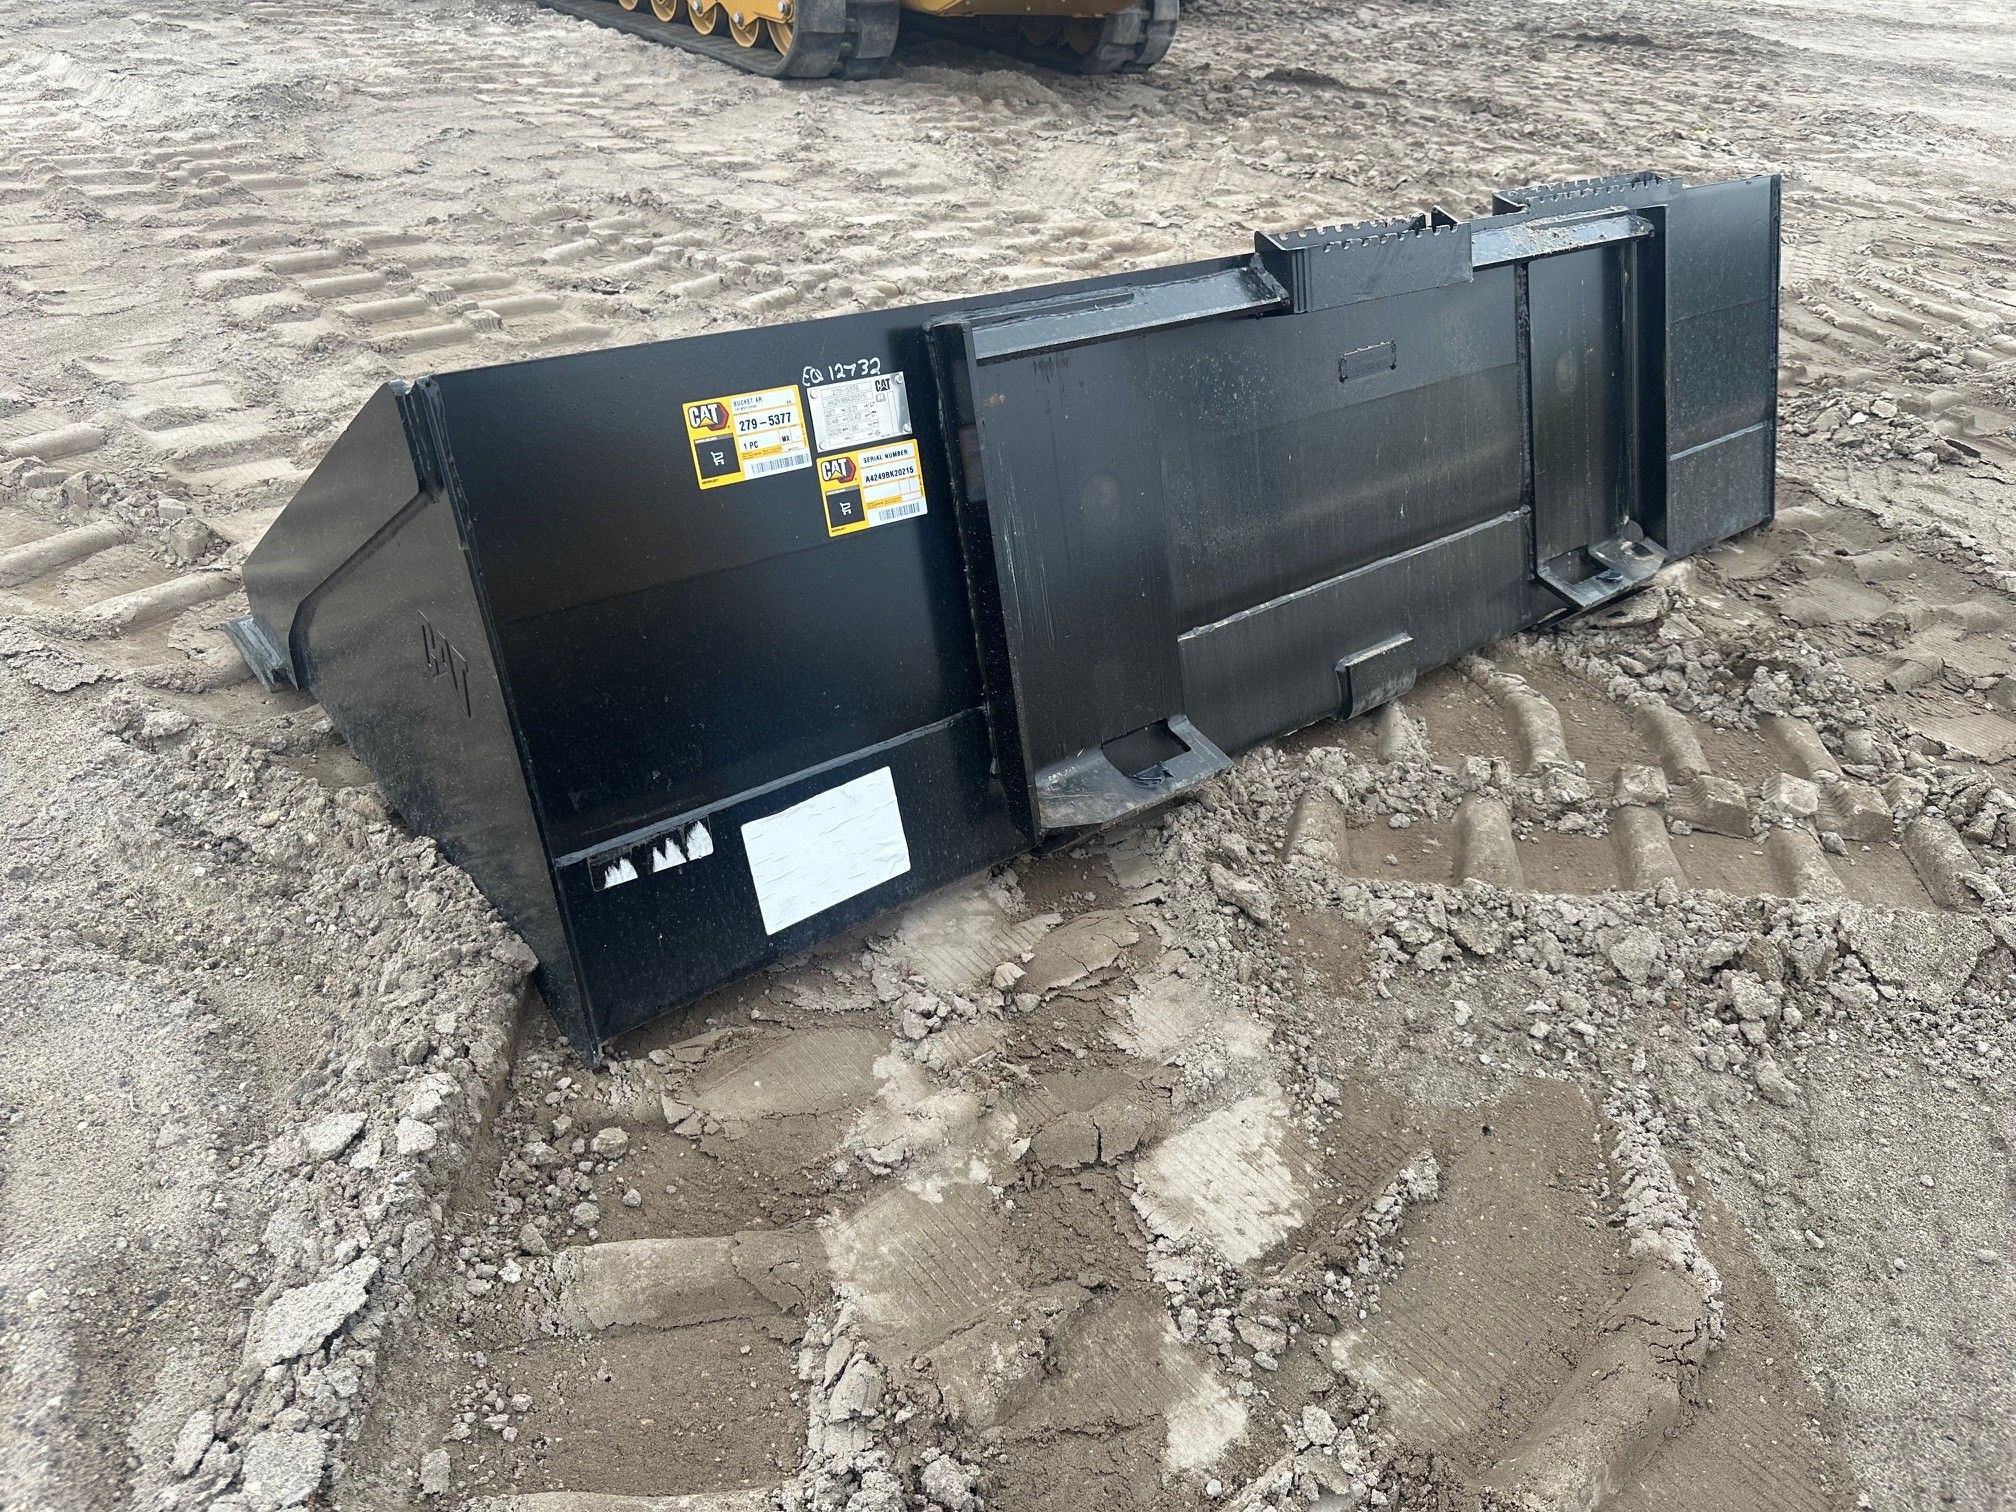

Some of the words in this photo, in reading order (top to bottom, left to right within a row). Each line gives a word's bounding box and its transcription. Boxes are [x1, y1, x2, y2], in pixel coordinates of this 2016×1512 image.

[802, 366, 824, 386] EQ
[828, 357, 881, 381] 12732
[875, 378, 891, 392] CAT
[733, 397, 753, 407] BUCKET
[688, 403, 719, 428] CAT
[749, 441, 759, 449] PC
[863, 455, 883, 464] SERIAL
[884, 449, 908, 459] NUMBER
[821, 458, 848, 481] CAT
[865, 466, 914, 483] A4249BK20215
